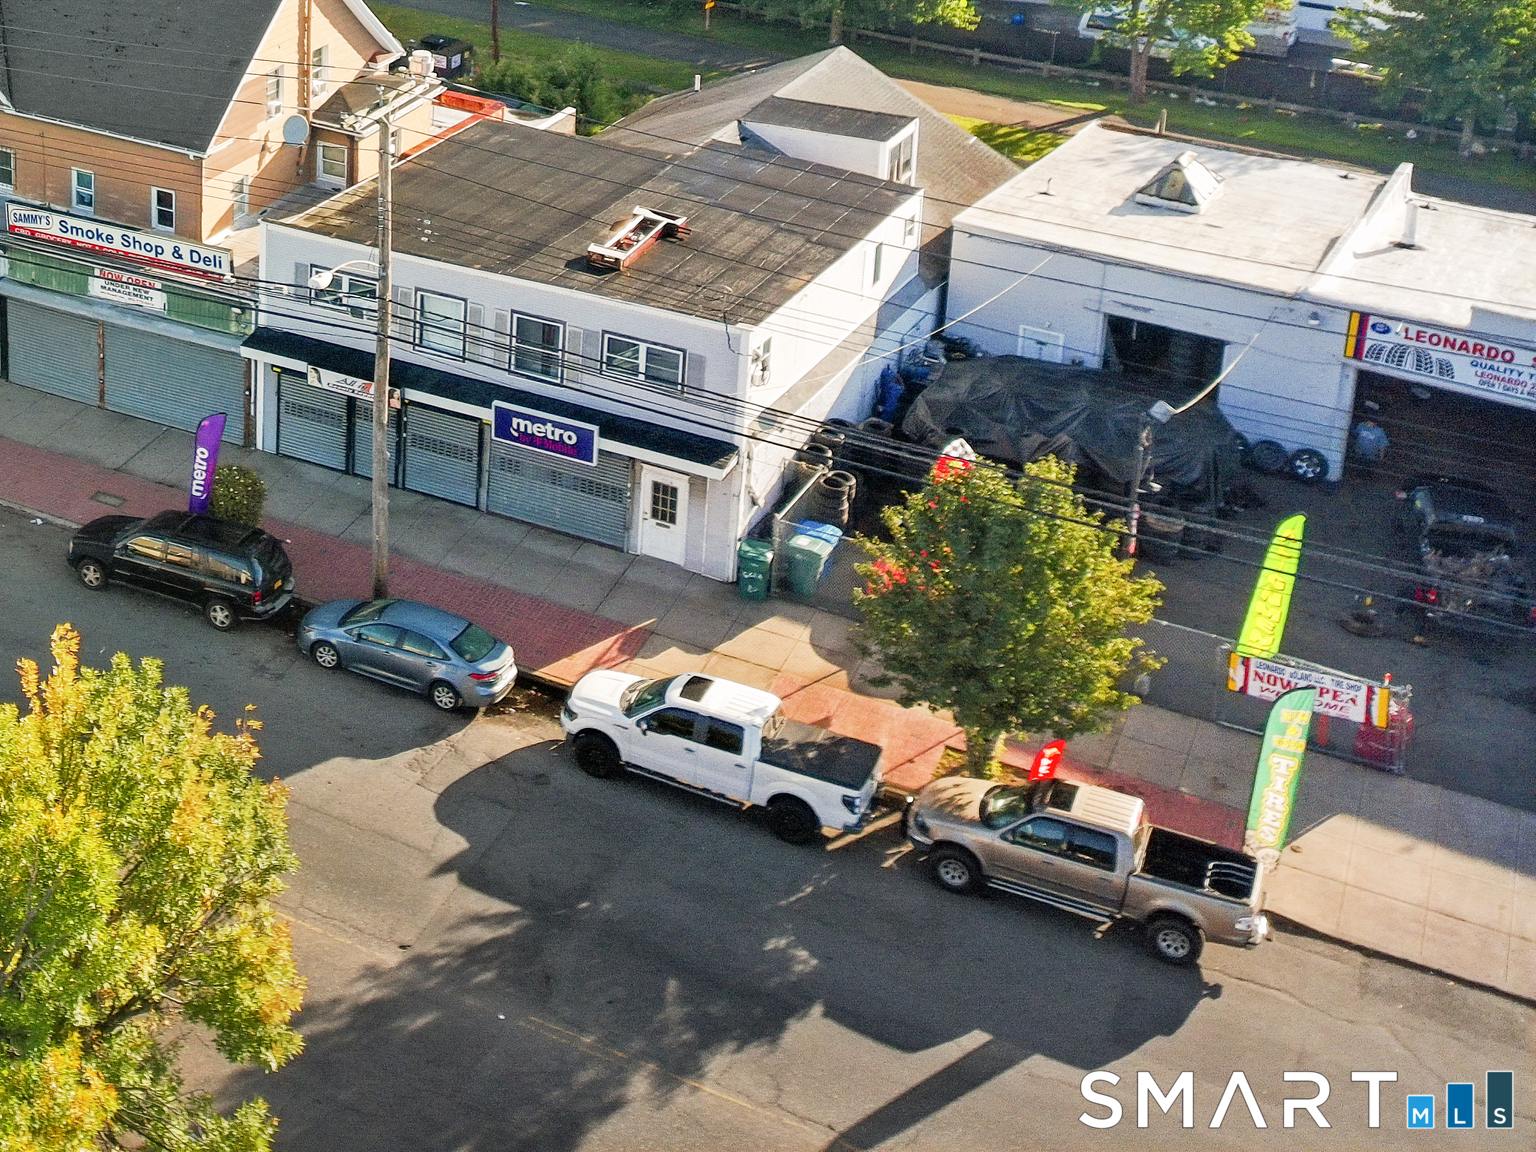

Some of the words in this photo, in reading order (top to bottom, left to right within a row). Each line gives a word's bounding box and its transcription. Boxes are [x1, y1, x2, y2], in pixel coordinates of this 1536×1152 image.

[13, 212, 51, 226] SAMMY'S
[58, 219, 114, 245] Smoke
[120, 233, 165, 258] Shop
[171, 245, 184, 261] &
[189, 249, 223, 270] Deli
[99, 270, 124, 282] NOW
[126, 276, 156, 288] OPEN
[104, 280, 131, 291] UNDER
[132, 286, 151, 296] NEW
[100, 284, 154, 302] MANAGEMENT
[1403, 326, 1516, 364] LEONARDO
[1470, 359, 1525, 378] QUALITY
[1474, 370, 1528, 388] LEONARDO
[511, 416, 578, 446] metro
[191, 446, 210, 498] metro
[1255, 660, 1287, 676] LEONARDO
[1253, 669, 1300, 690] NOW
[1304, 683, 1358, 707] PEN
[1259, 755, 1297, 843] TIRES
